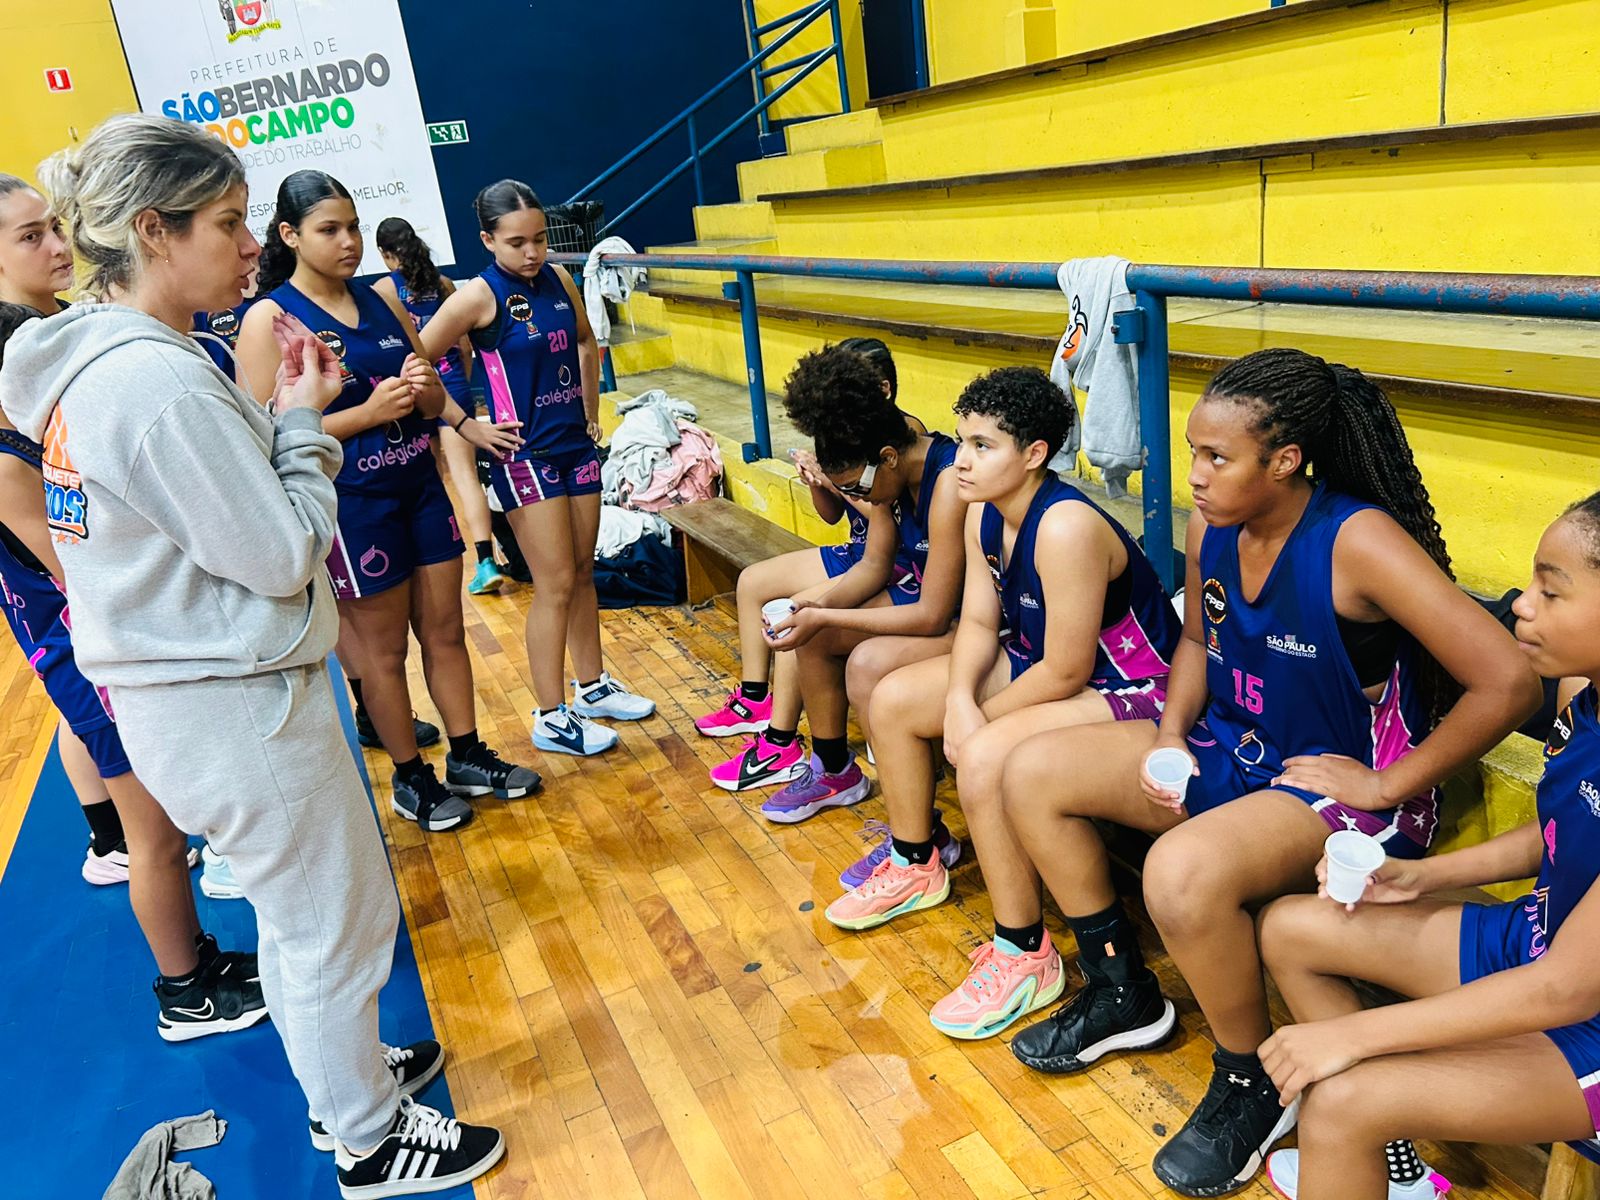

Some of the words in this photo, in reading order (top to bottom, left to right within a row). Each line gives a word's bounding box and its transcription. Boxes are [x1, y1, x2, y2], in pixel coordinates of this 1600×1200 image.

[190, 46, 303, 83] PREFEITURA
[313, 37, 338, 56] DE
[265, 149, 286, 166] DO
[288, 134, 362, 161] TRABALHO
[353, 181, 409, 201] MELHOR.
[511, 302, 530, 313] FPB
[211, 314, 235, 328] FPB
[547, 329, 568, 353] 20
[575, 460, 600, 485] 20
[1204, 592, 1226, 611] FPB
[1266, 634, 1284, 648] SÃO
[1284, 641, 1317, 653] PAULO
[585, 690, 604, 702] NIKE
[1232, 668, 1264, 715] 15
[1553, 717, 1571, 741] PB
[1579, 780, 1599, 800] SÃO
